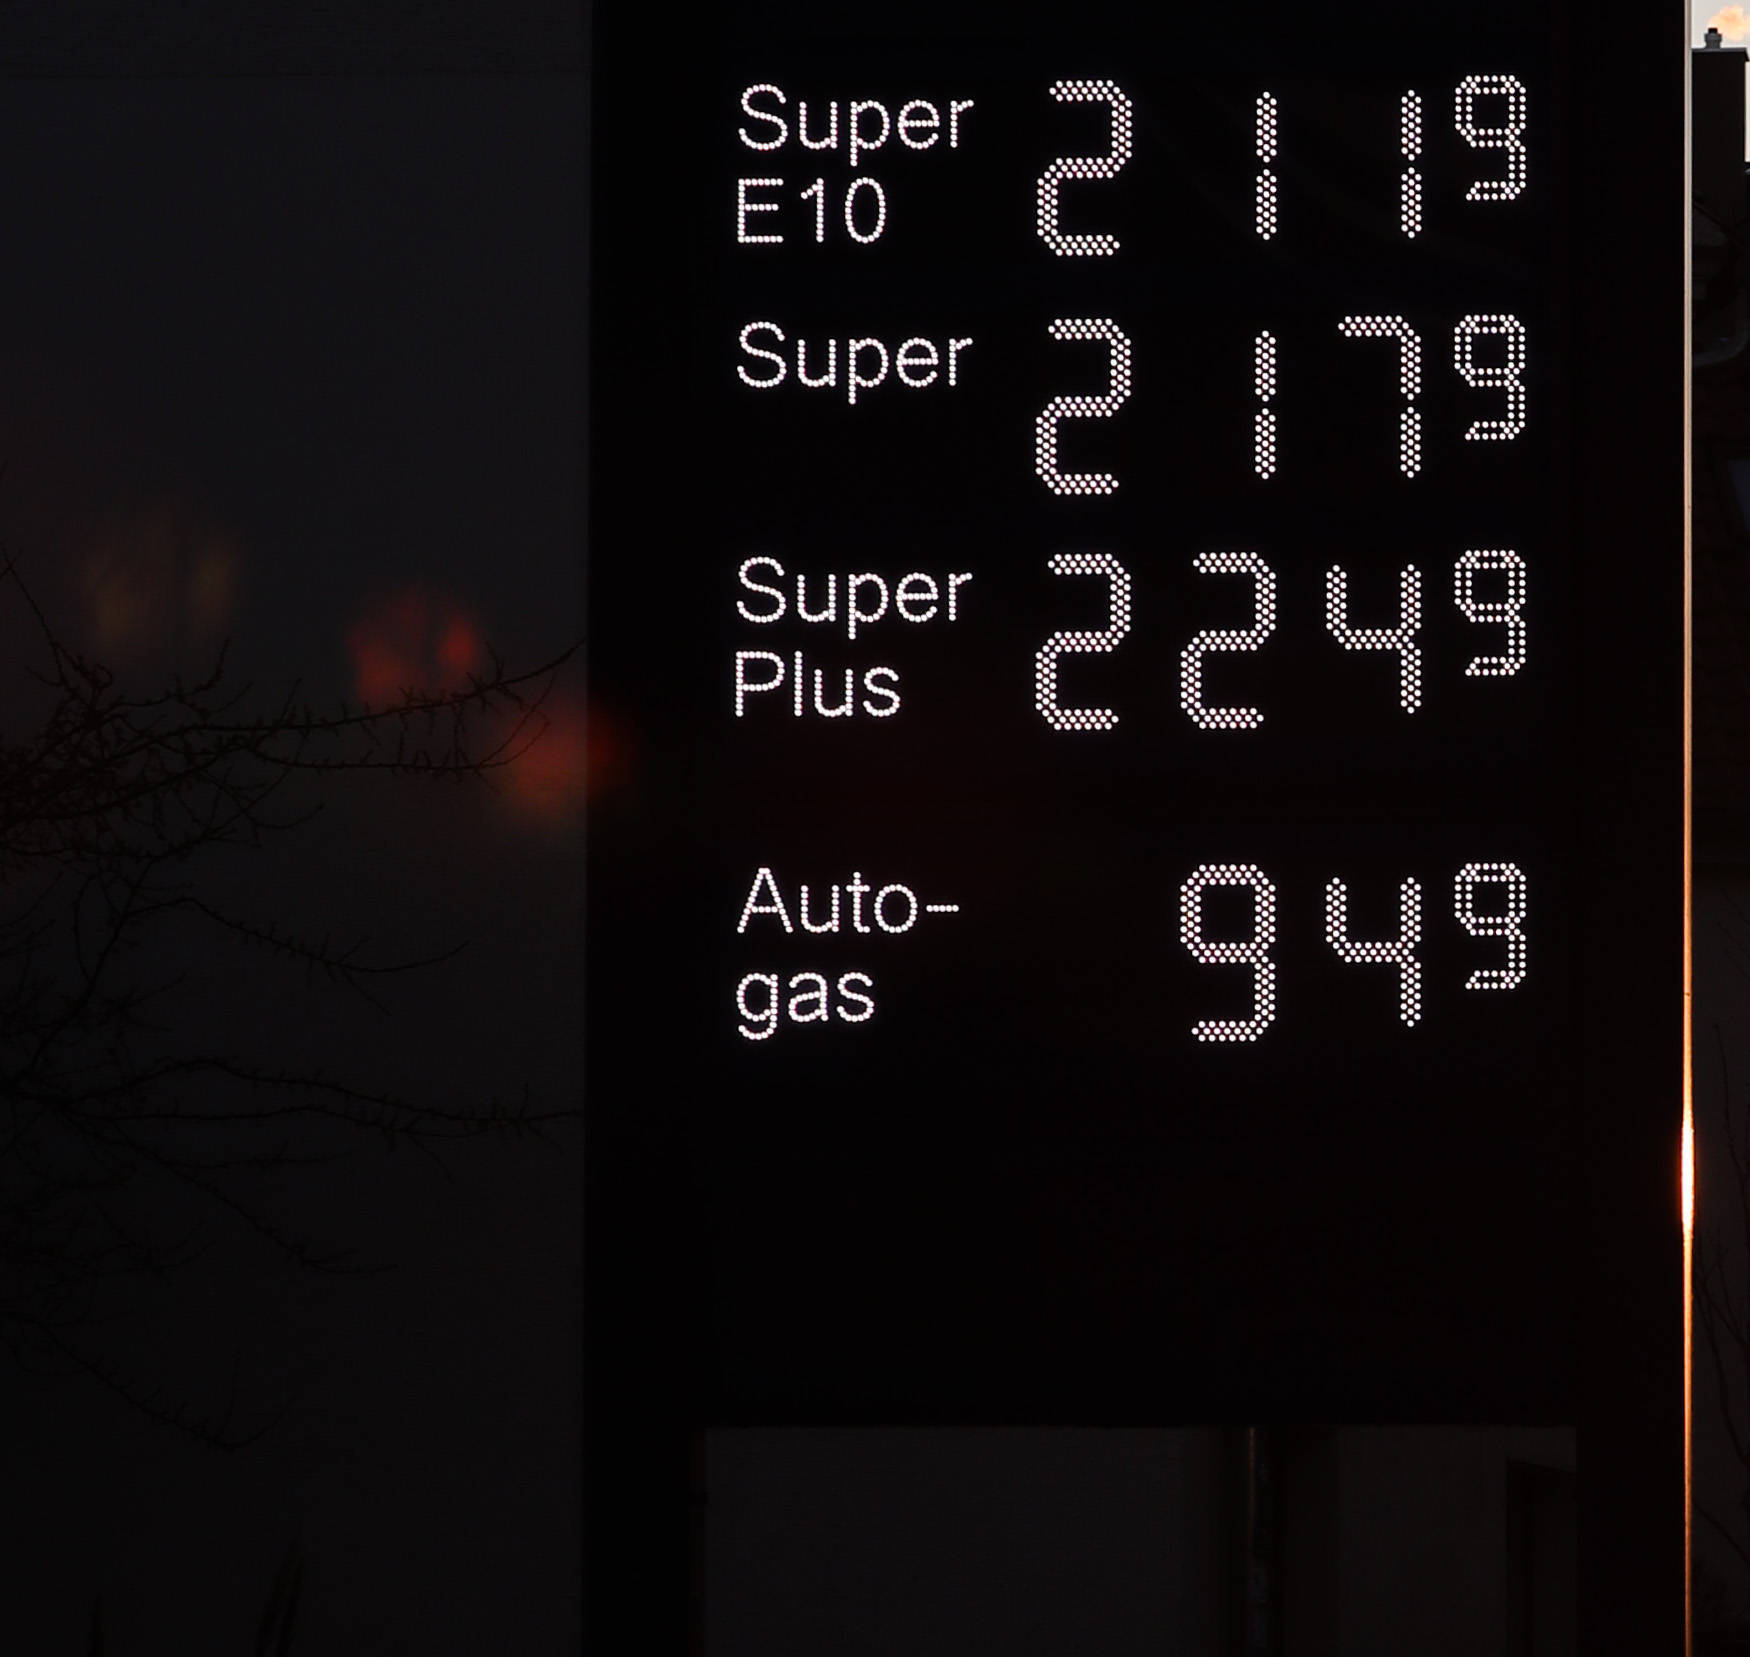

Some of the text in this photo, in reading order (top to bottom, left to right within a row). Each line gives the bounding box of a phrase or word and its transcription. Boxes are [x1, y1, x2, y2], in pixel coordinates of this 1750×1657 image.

[738, 83, 975, 167] Super
[737, 176, 887, 244] E10
[736, 321, 974, 405] Super
[736, 556, 973, 640] Super
[735, 650, 901, 718] Plus
[736, 867, 960, 934] Auto-
[736, 971, 875, 1041] gas
